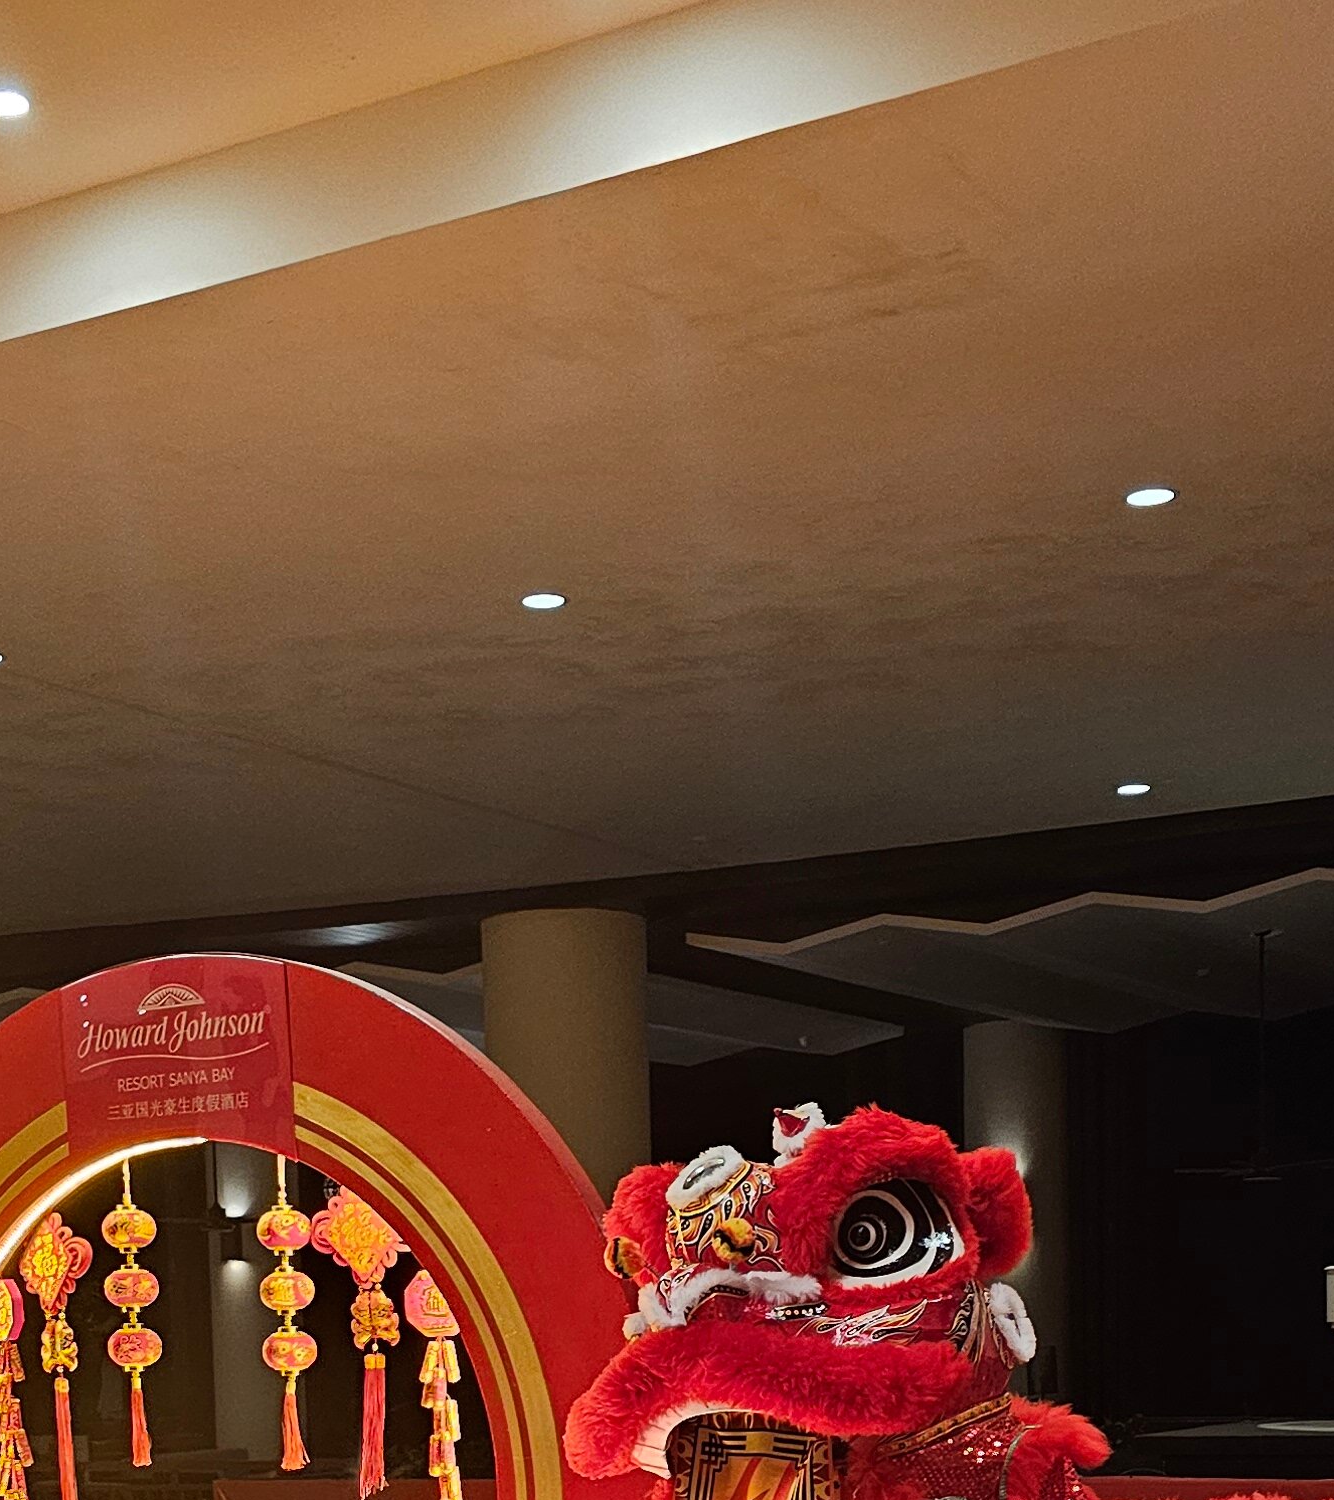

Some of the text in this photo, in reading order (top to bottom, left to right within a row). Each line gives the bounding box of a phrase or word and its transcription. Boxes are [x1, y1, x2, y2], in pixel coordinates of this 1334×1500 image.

[77, 1010, 267, 1059] Howard Johnson
[117, 1067, 236, 1092] RESORT SANYA BAY
[107, 1092, 250, 1121] 三亚国光豪生度假酒店
